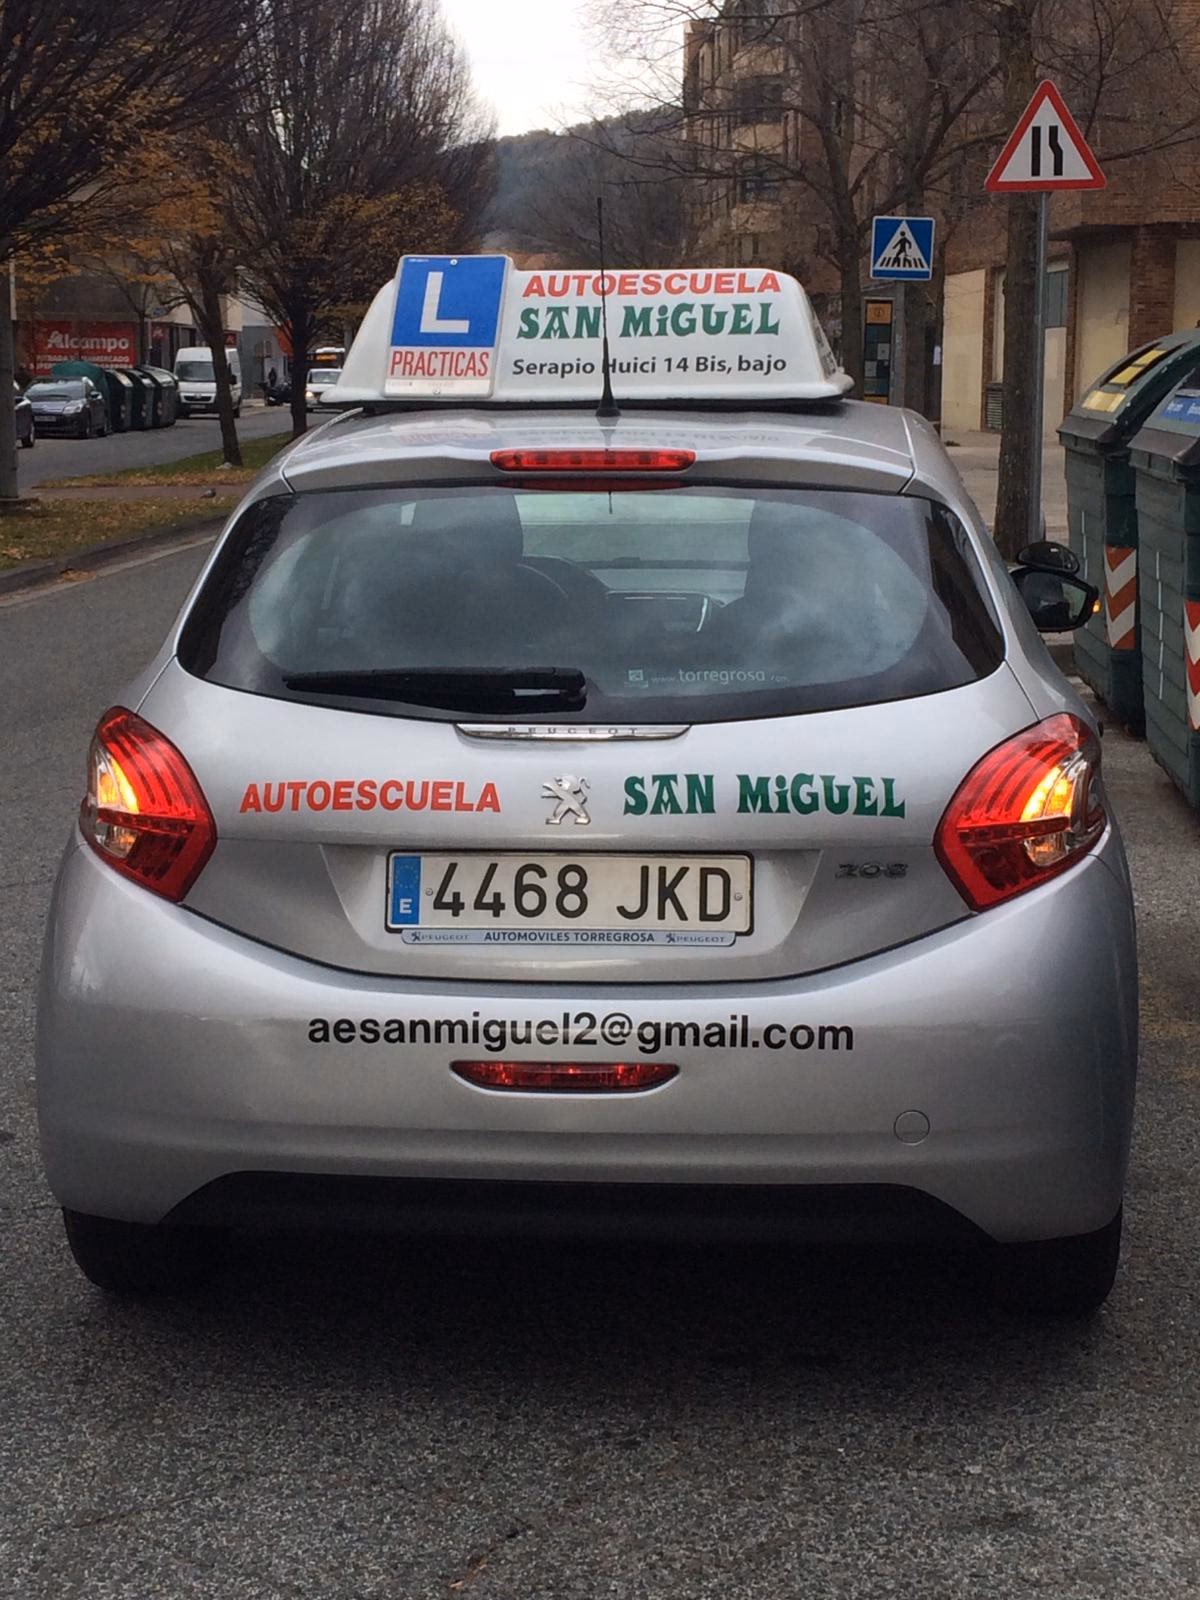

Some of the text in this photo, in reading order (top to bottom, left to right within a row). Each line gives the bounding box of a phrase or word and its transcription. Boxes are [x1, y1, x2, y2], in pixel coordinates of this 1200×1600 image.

[521, 271, 782, 298] AUTOESCUELA
[419, 270, 471, 334] L
[515, 305, 604, 340] SAN
[47, 330, 130, 352] Alcampo
[389, 350, 491, 378] PRACTICAS
[511, 353, 788, 379] Serapio Huici 14 Bis, bajo
[507, 726, 639, 736] PEUGEOT
[238, 779, 502, 814] AUTOESCUELA
[622, 773, 717, 816] SAN
[398, 897, 413, 914] E
[432, 862, 732, 923] 4468 JKD
[420, 931, 726, 944] PEUGEOT AUTOMOVILES TORREGROSA PEUGEOT
[307, 1010, 854, 1053] aesanmiguel2@gmail.com
